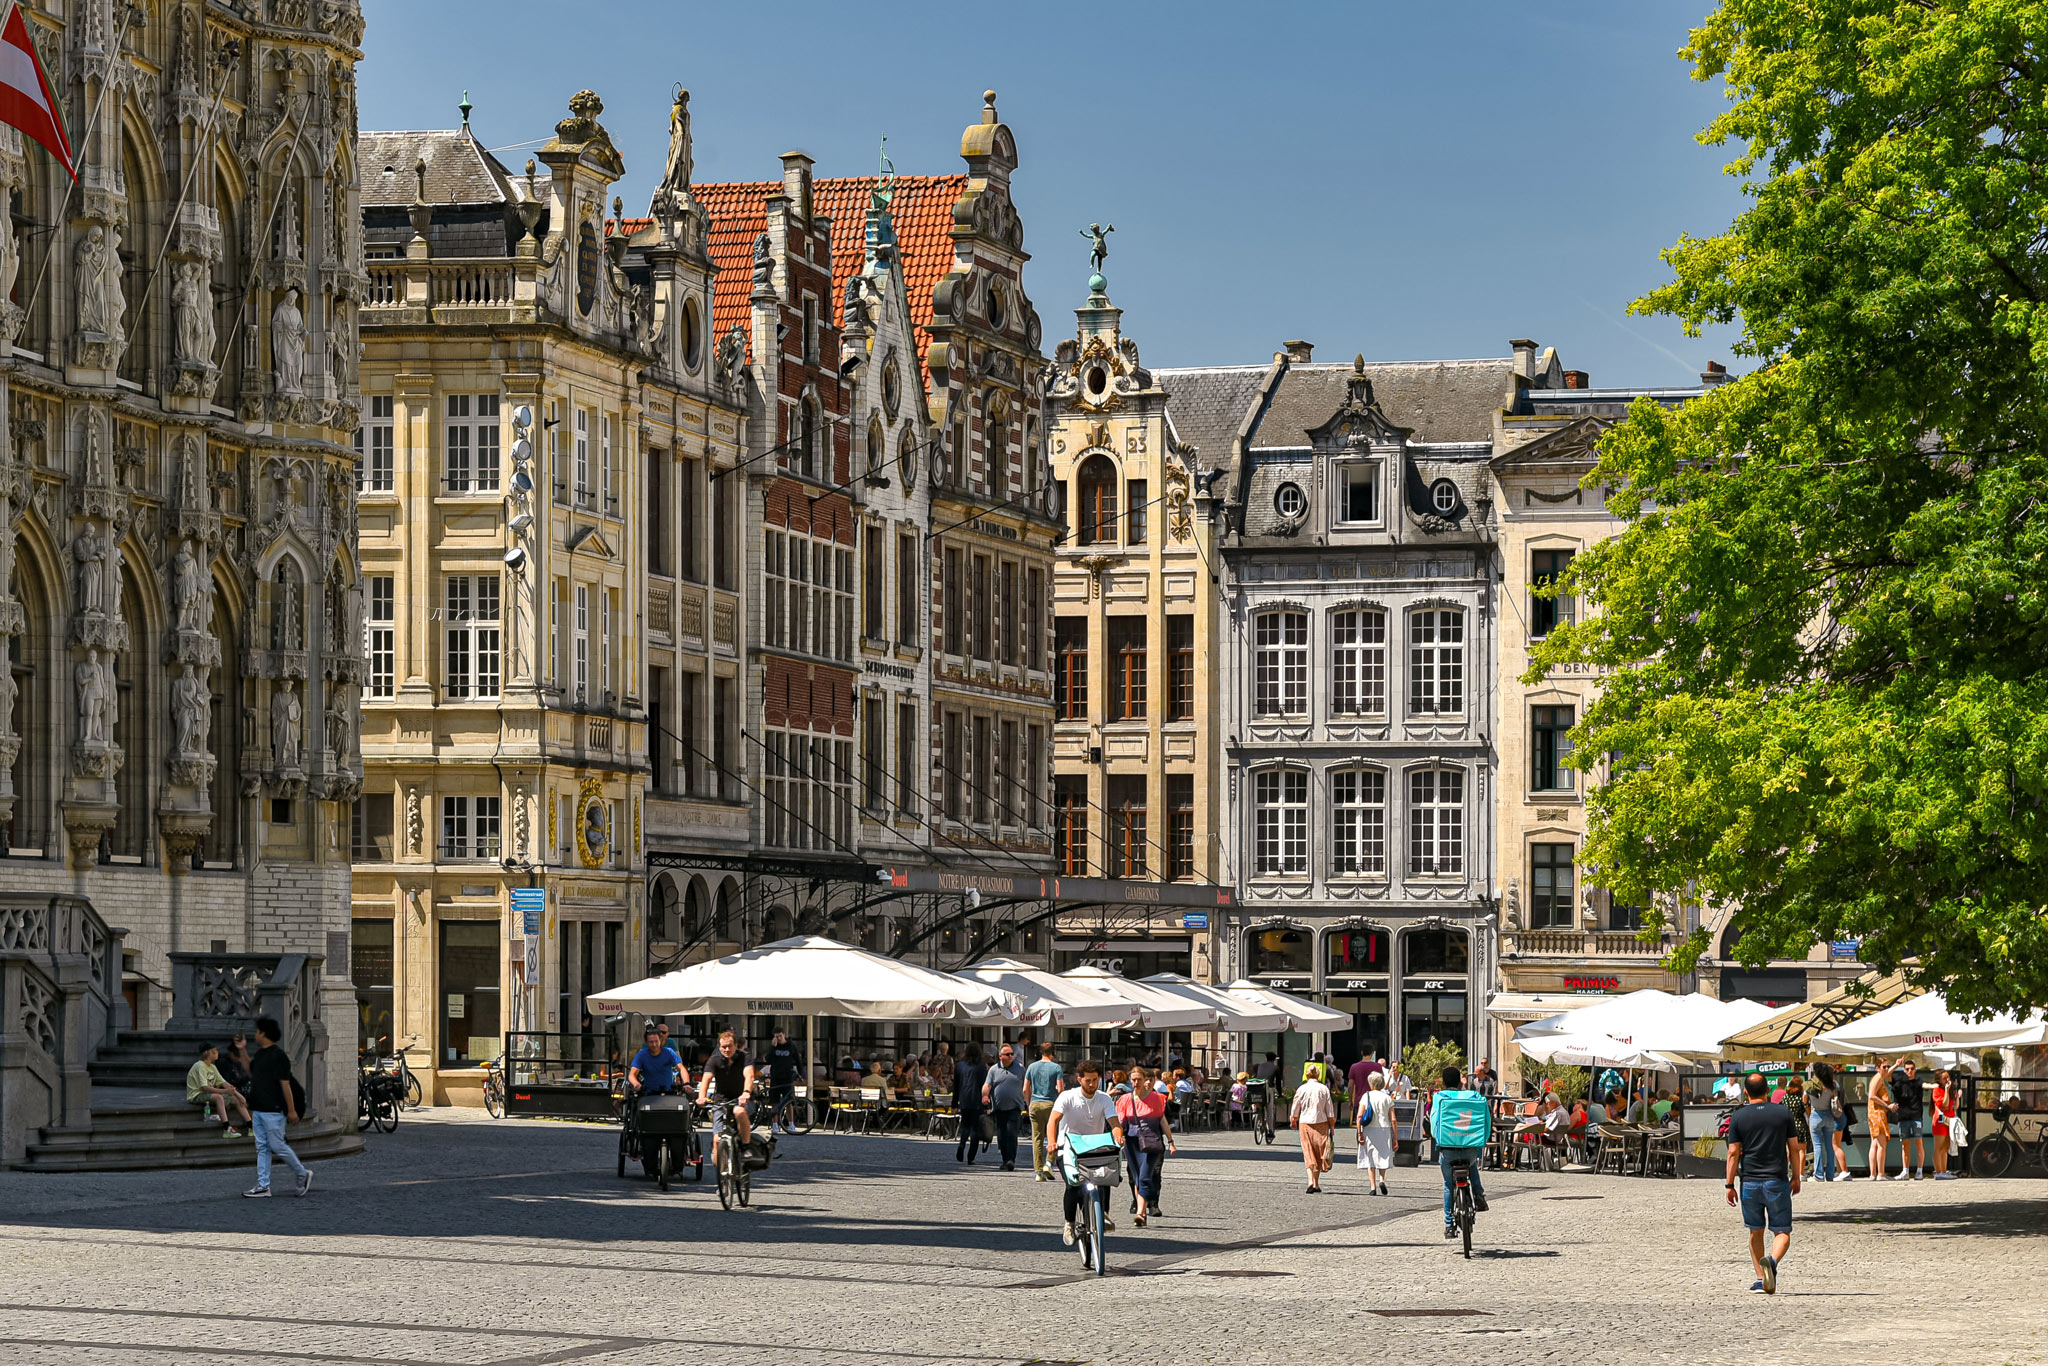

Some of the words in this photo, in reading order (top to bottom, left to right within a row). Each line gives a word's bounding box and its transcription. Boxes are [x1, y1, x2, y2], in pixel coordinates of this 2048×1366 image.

[1050, 438, 1066, 455] 19
[1128, 436, 1147, 453] 23
[1563, 662, 1590, 674] DEN
[891, 867, 908, 887] Duvel
[938, 873, 960, 890] NOTRE
[1125, 886, 1160, 901] GAMBRINUS
[1270, 979, 1290, 988] KFC
[1347, 980, 1367, 989] KFC
[1424, 981, 1444, 989] KFC
[1563, 976, 1620, 989] PRIMUS
[598, 1001, 623, 1011] Duvel
[747, 1000, 757, 1010] HET
[921, 1004, 947, 1014] Duvel
[1020, 1012, 1043, 1021] Duvel
[1914, 1032, 1944, 1044] Duvel
